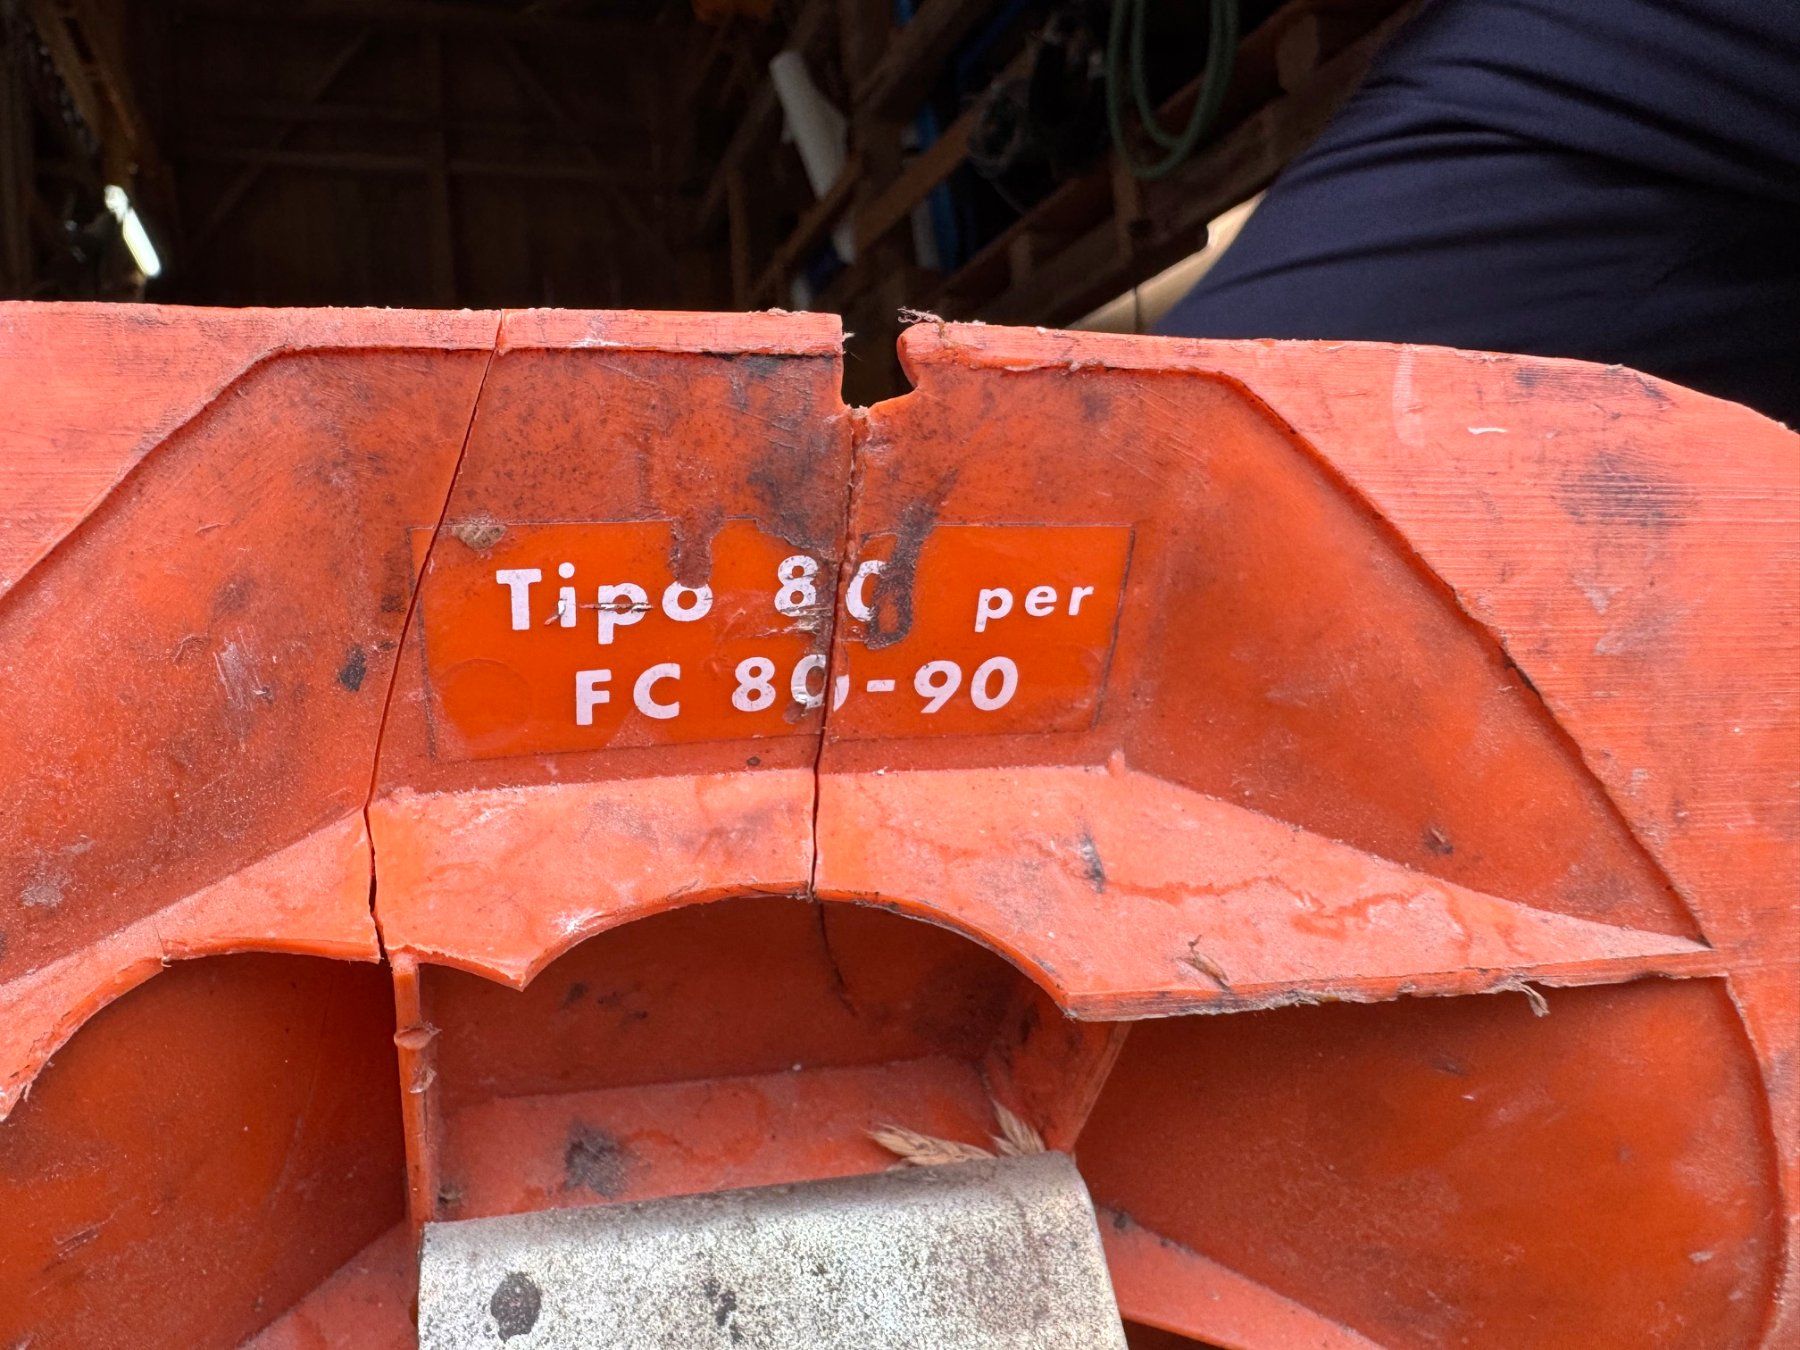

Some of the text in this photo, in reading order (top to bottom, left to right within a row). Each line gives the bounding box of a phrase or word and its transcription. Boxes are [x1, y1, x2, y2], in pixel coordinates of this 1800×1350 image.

[496, 562, 713, 645] Tipo
[975, 585, 1095, 632] per
[575, 662, 681, 726] FC
